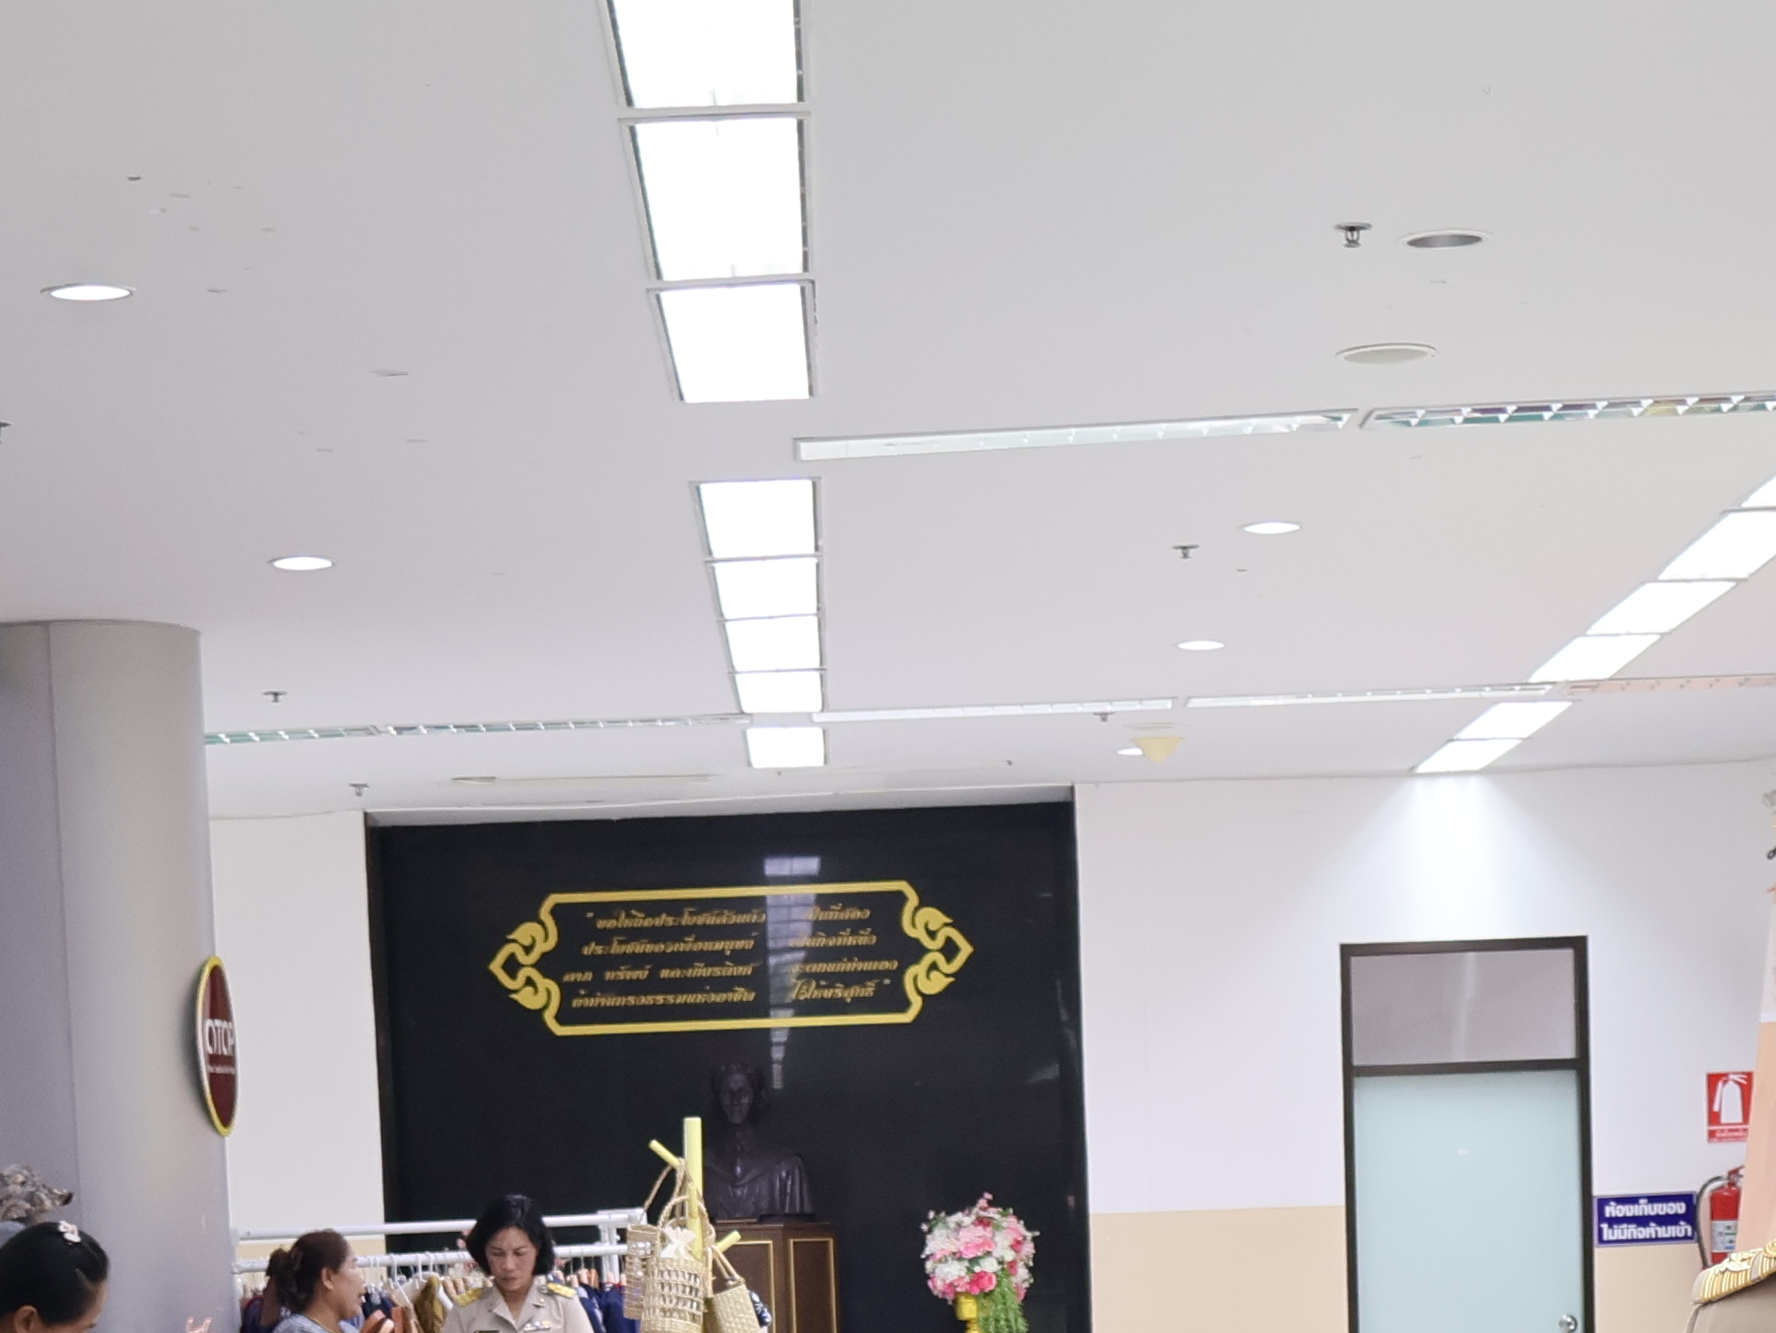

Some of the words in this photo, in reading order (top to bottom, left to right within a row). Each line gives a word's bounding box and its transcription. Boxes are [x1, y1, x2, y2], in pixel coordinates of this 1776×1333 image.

[1605, 1198, 1686, 1218] ห้องเก็บของ
[1600, 1221, 1692, 1241] ไม่มีกิจห้ามเข้า
